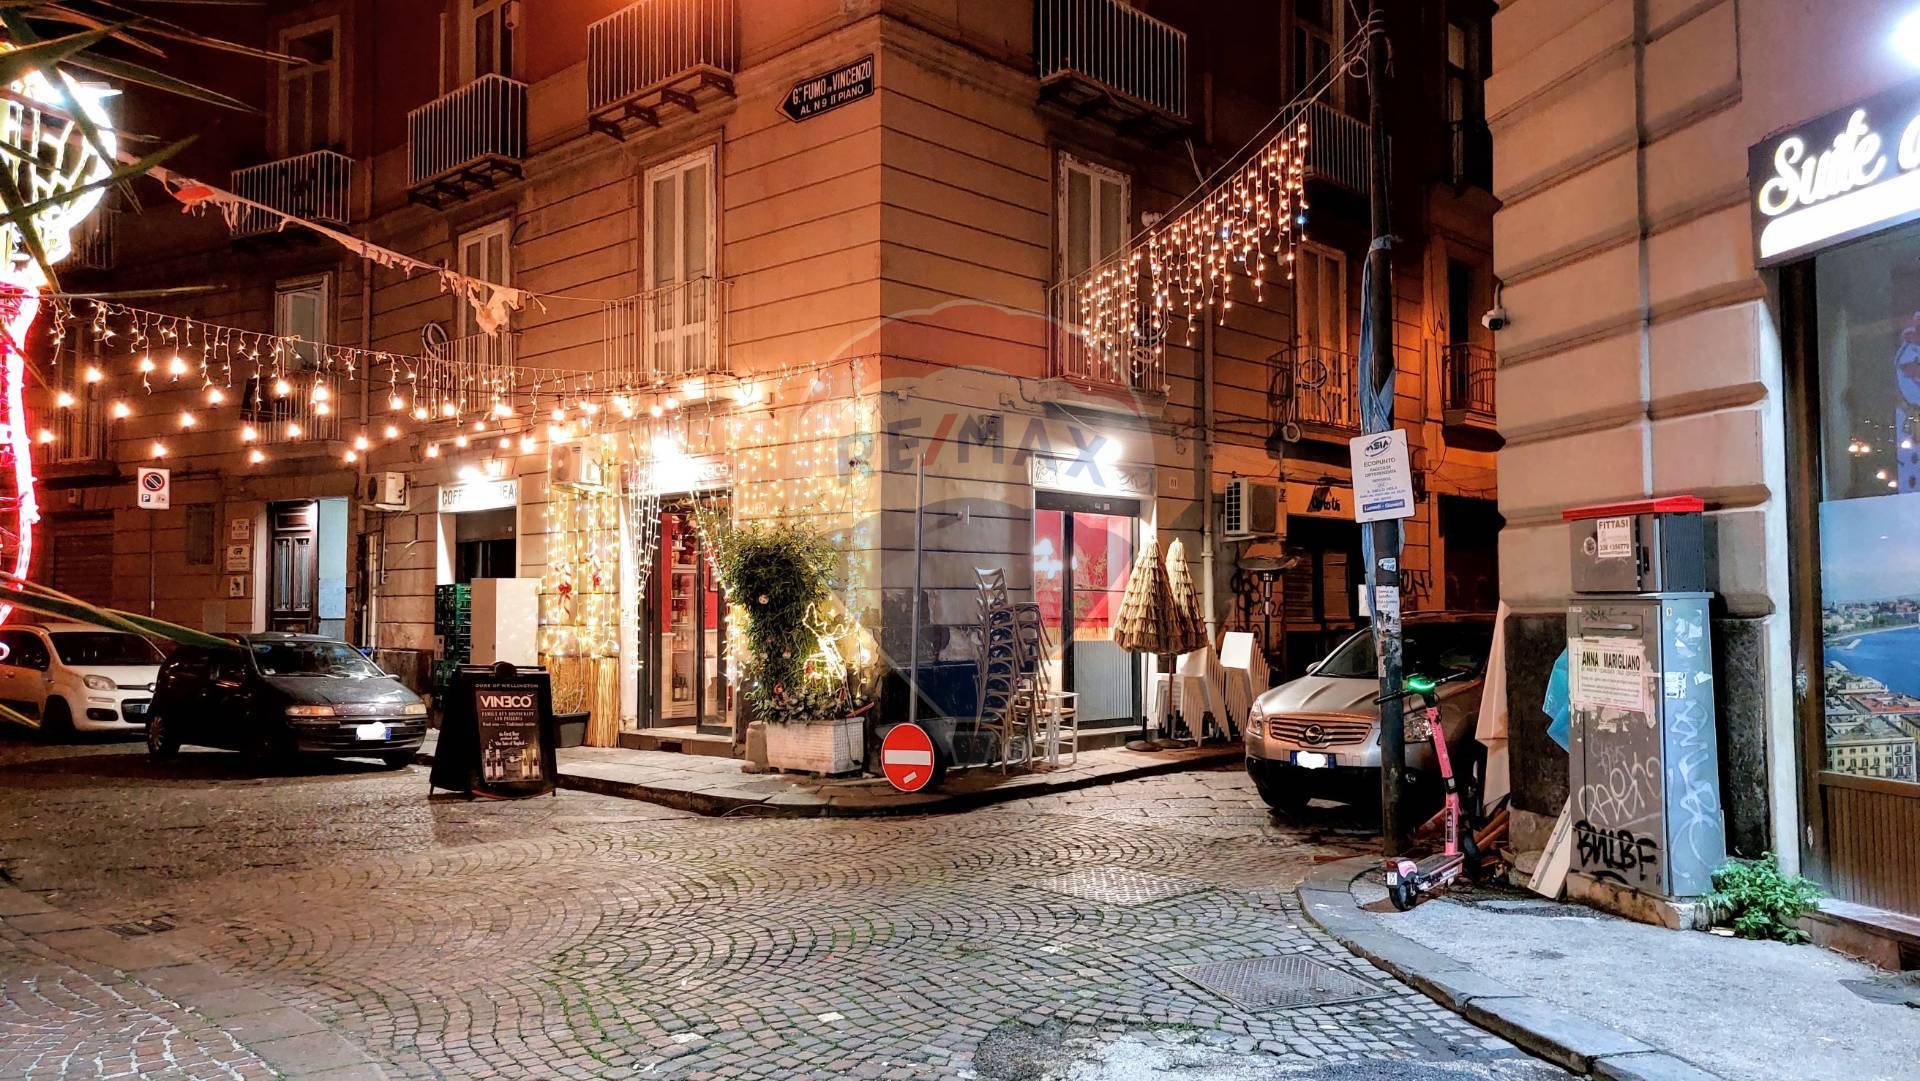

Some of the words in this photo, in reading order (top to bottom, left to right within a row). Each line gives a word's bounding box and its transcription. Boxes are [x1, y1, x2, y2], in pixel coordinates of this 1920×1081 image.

[803, 79, 827, 102] FUMO
[832, 60, 871, 91] VINCENZO
[800, 104, 811, 115] AL
[838, 84, 864, 101] PIANO
[1758, 109, 1887, 216] Suite
[1366, 440, 1389, 451] ASIA
[1363, 457, 1396, 468] ECOPUNTO
[1599, 519, 1629, 529] FITTASI
[1582, 651, 1599, 667] ANNA
[1603, 652, 1641, 671] MARIGLIANO
